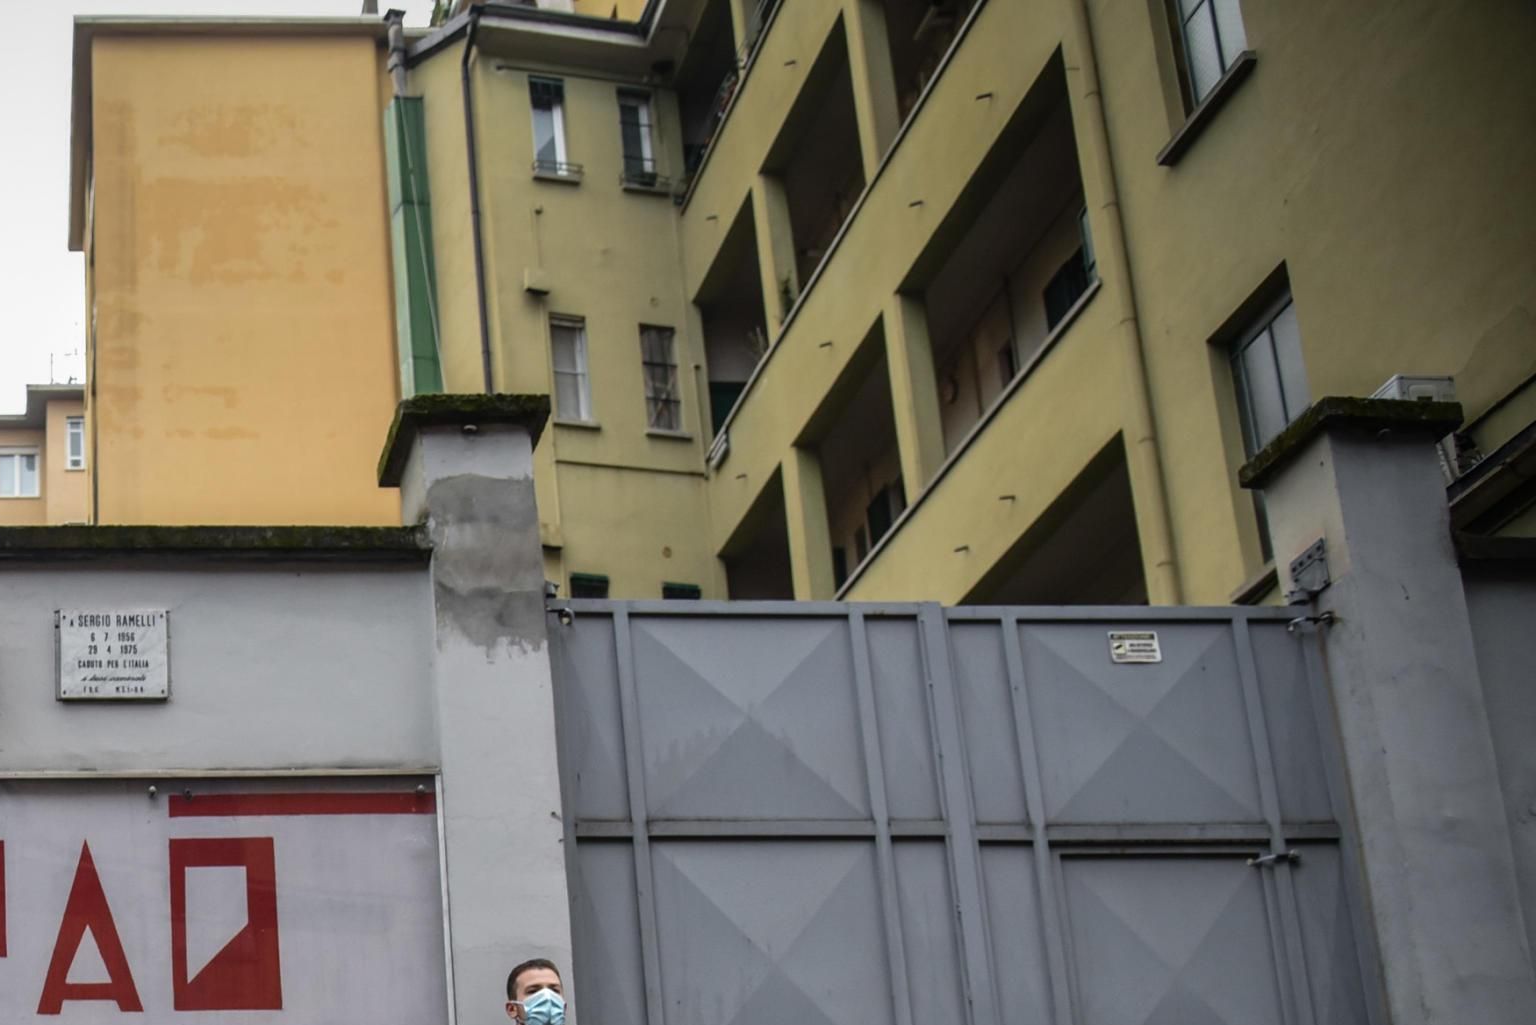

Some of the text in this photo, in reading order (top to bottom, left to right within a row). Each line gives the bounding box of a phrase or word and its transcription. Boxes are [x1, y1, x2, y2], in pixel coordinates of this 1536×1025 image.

[78, 614, 111, 627] SERGIO
[116, 614, 156, 627] RAMELLI
[90, 632, 135, 642] 6 7 1956
[88, 644, 138, 655] 29 4 1975
